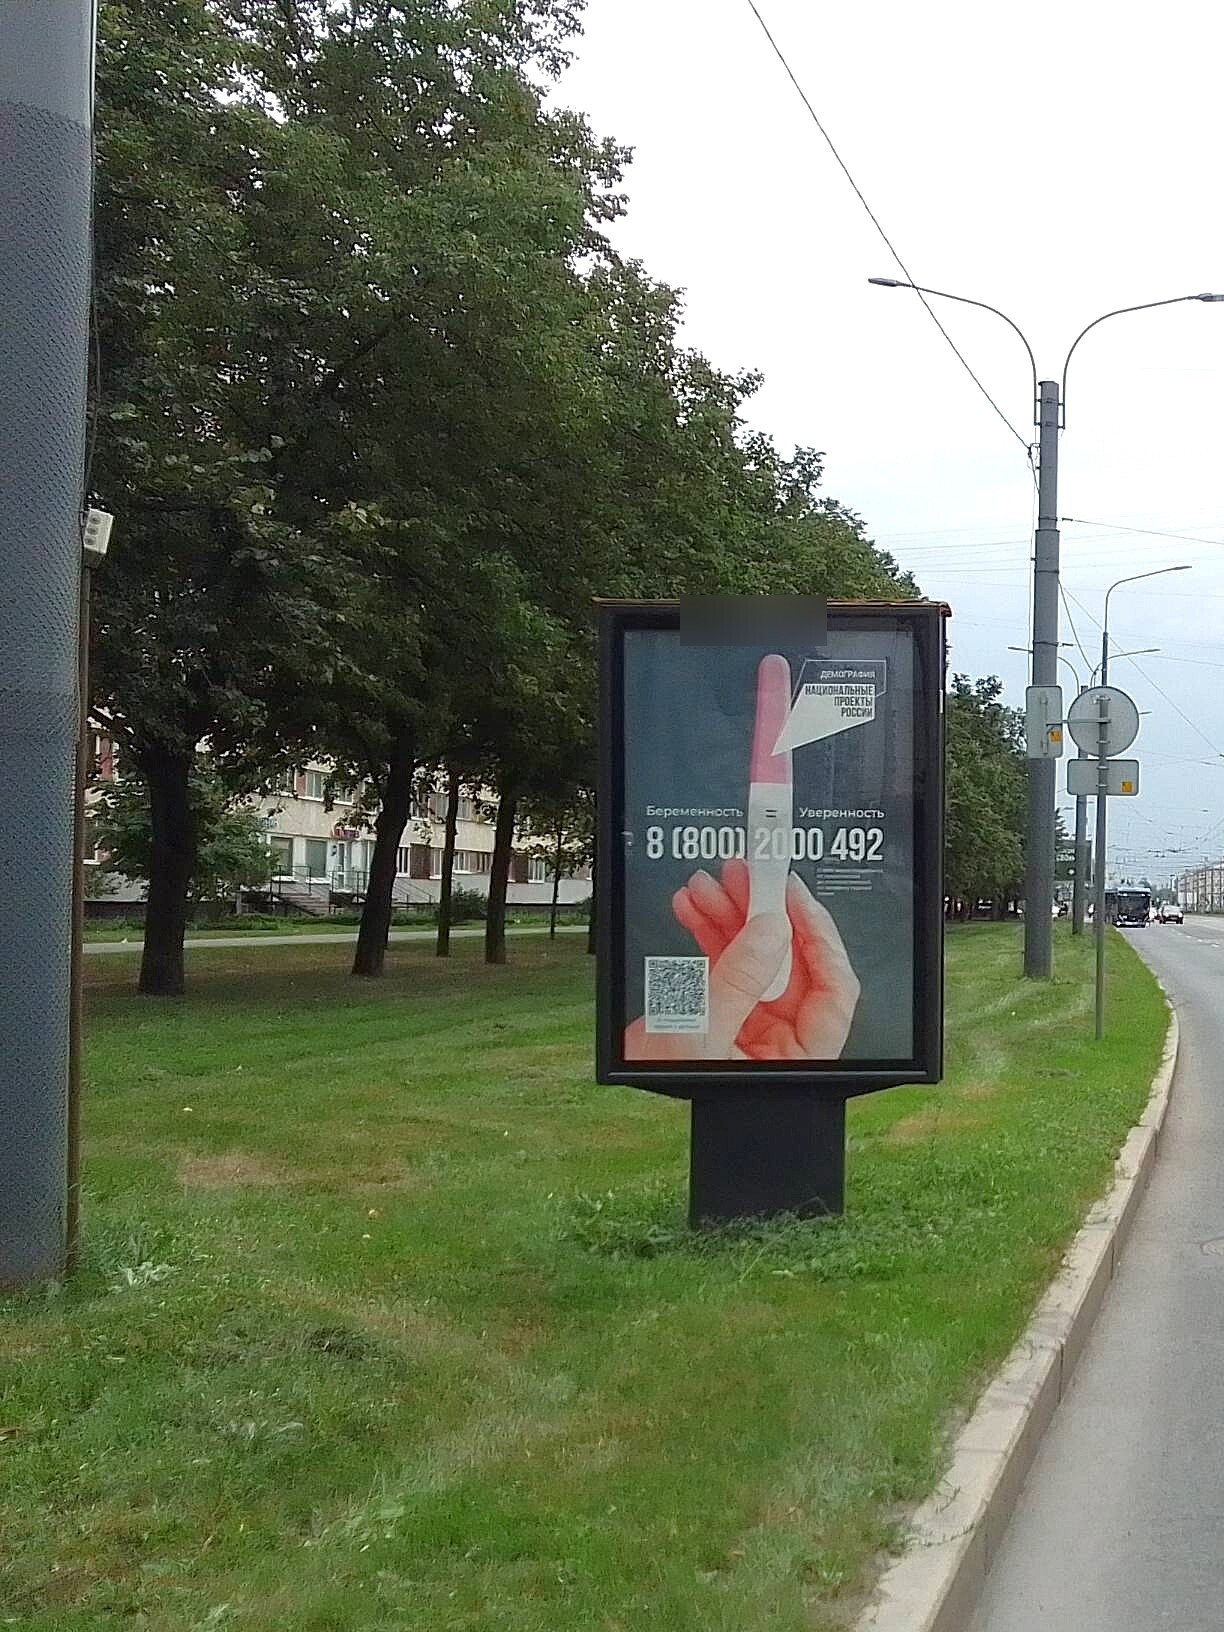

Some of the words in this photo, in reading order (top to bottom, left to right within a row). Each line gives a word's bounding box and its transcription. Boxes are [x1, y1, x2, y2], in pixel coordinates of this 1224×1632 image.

[820, 671, 876, 680] ДЕМОГРАФИЯ
[805, 685, 873, 696] НАЦИОНАЛЬНЫЕ
[834, 697, 873, 707] ПРОЕКТЫ
[841, 707, 873, 718] РОССИИ
[646, 805, 744, 818] Беременность
[799, 806, 885, 819] Уверенность
[646, 826, 664, 860] 8
[672, 826, 745, 860] (800)
[754, 827, 824, 861] 2000
[831, 827, 884, 861] 492
